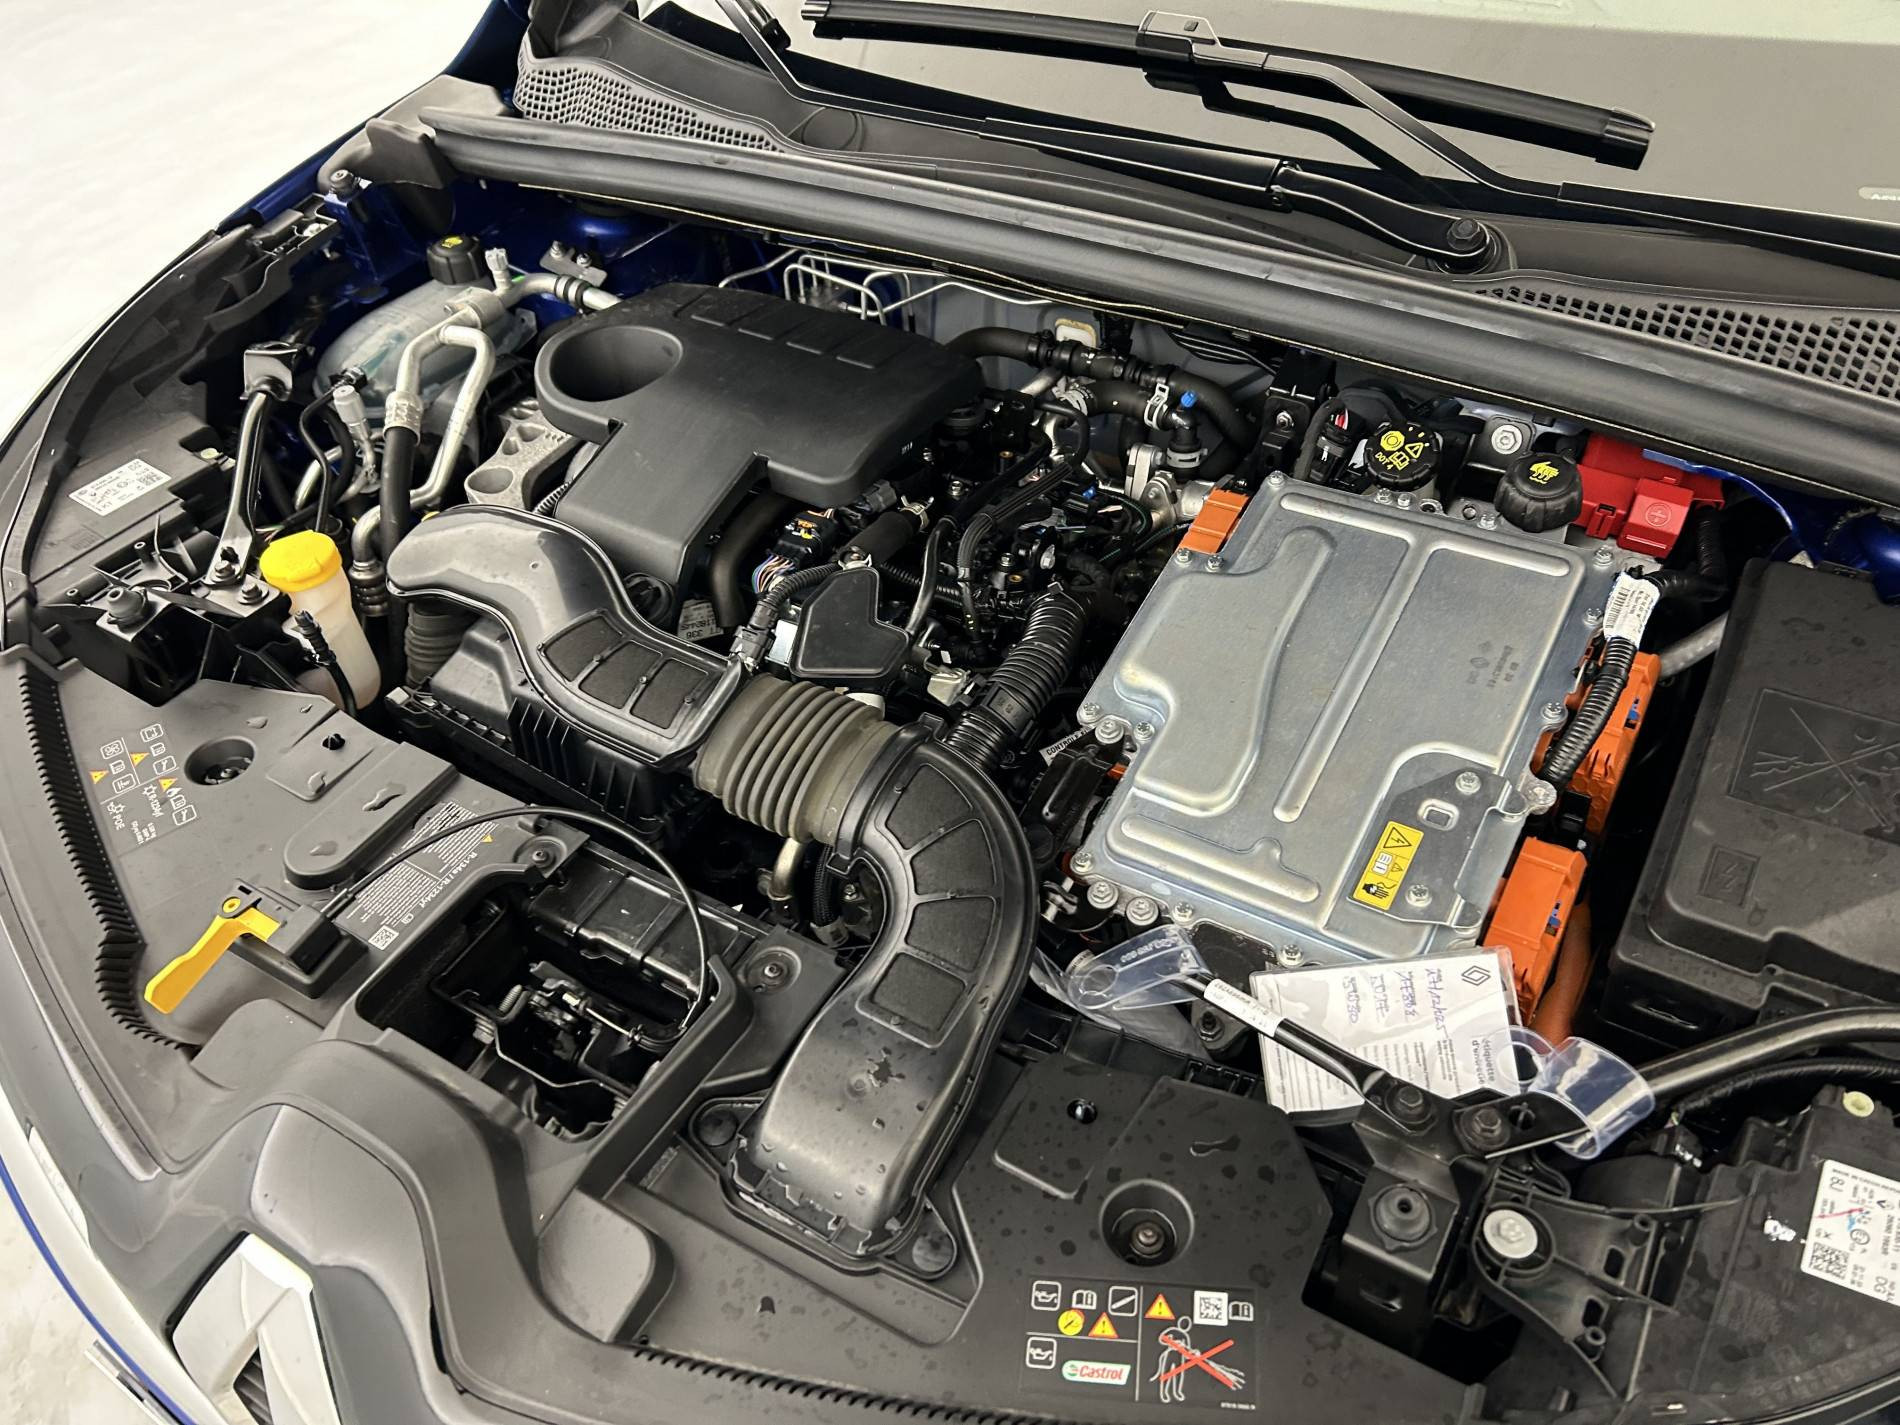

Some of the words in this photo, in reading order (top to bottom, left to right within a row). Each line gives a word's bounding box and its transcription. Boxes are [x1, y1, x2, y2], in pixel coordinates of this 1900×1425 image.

[1374, 451, 1390, 465] DOT
[114, 814, 126, 831] POE
[452, 852, 478, 876] R-134a
[419, 878, 450, 908] R-1234yf
[1079, 1364, 1124, 1380] Castrol
